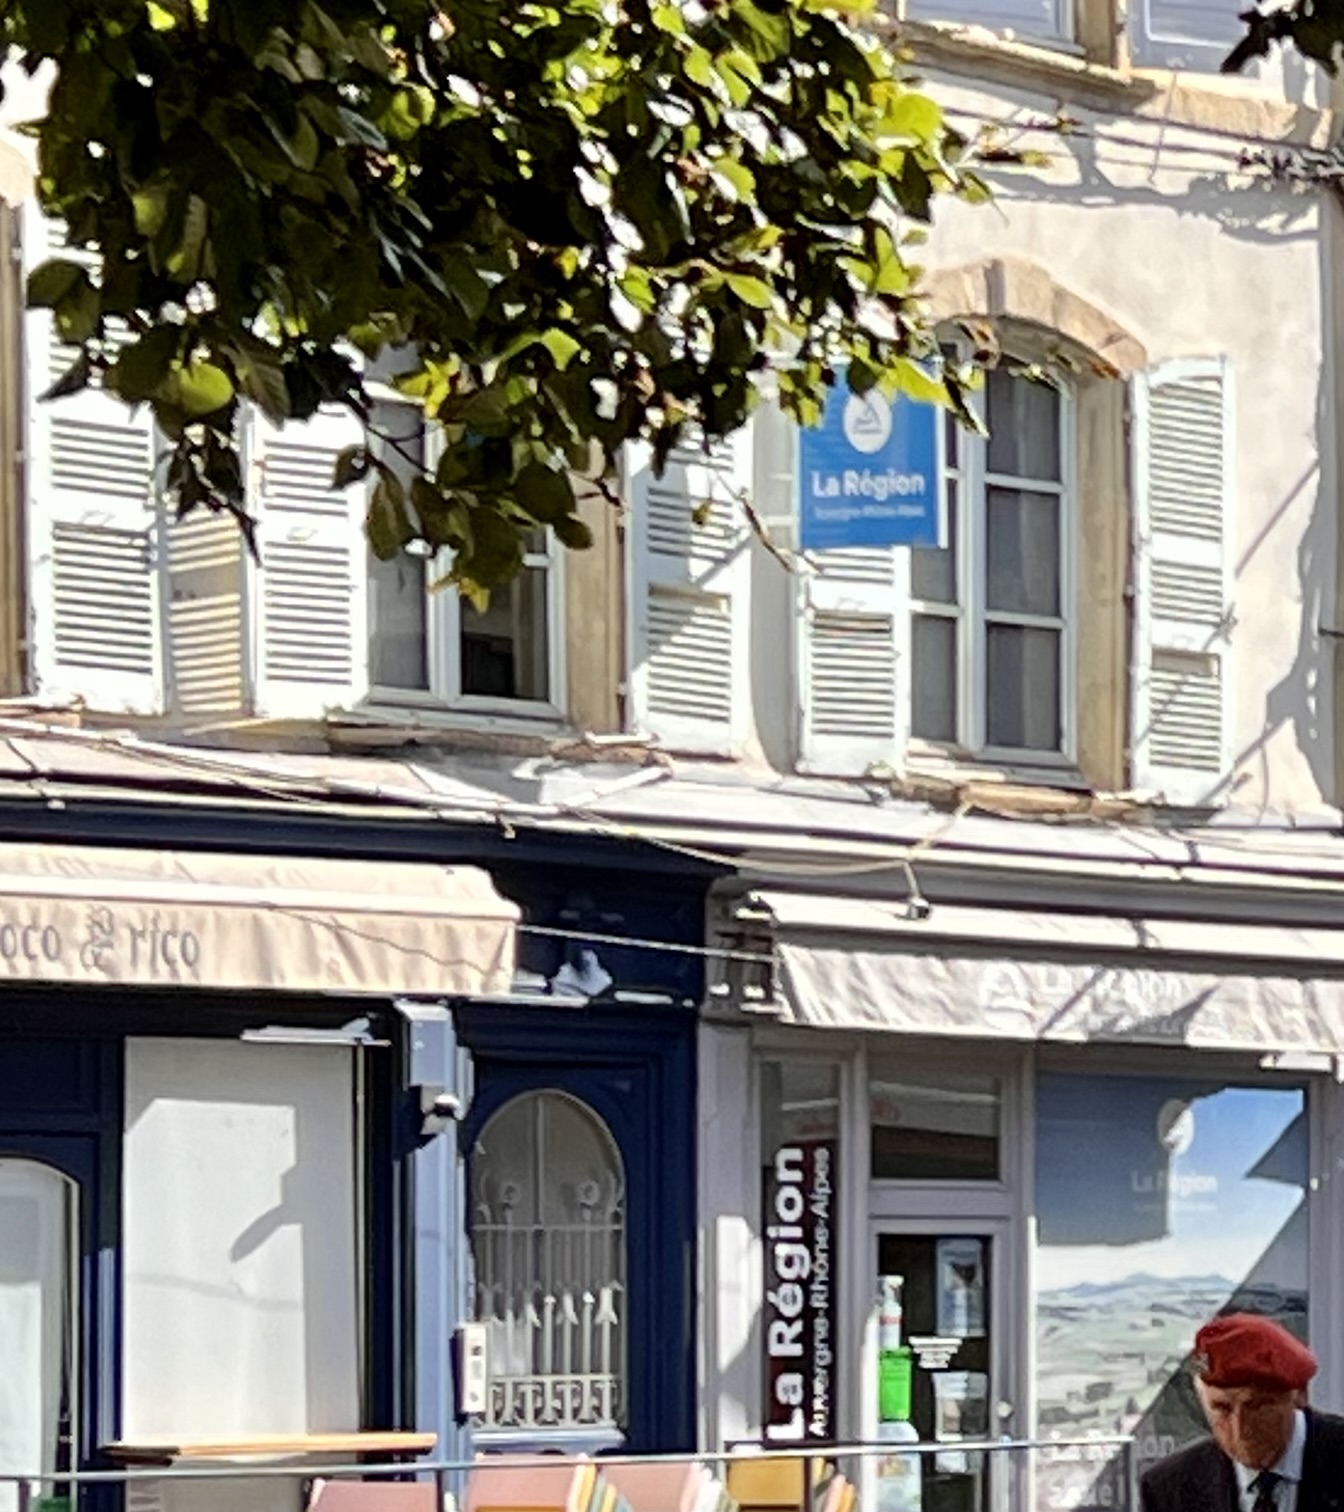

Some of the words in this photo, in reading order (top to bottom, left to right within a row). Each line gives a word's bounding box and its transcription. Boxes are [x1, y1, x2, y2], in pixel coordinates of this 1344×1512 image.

[811, 470, 840, 497] La
[843, 467, 926, 502] Région
[765, 1147, 812, 1358] Région
[765, 1371, 805, 1440] La
